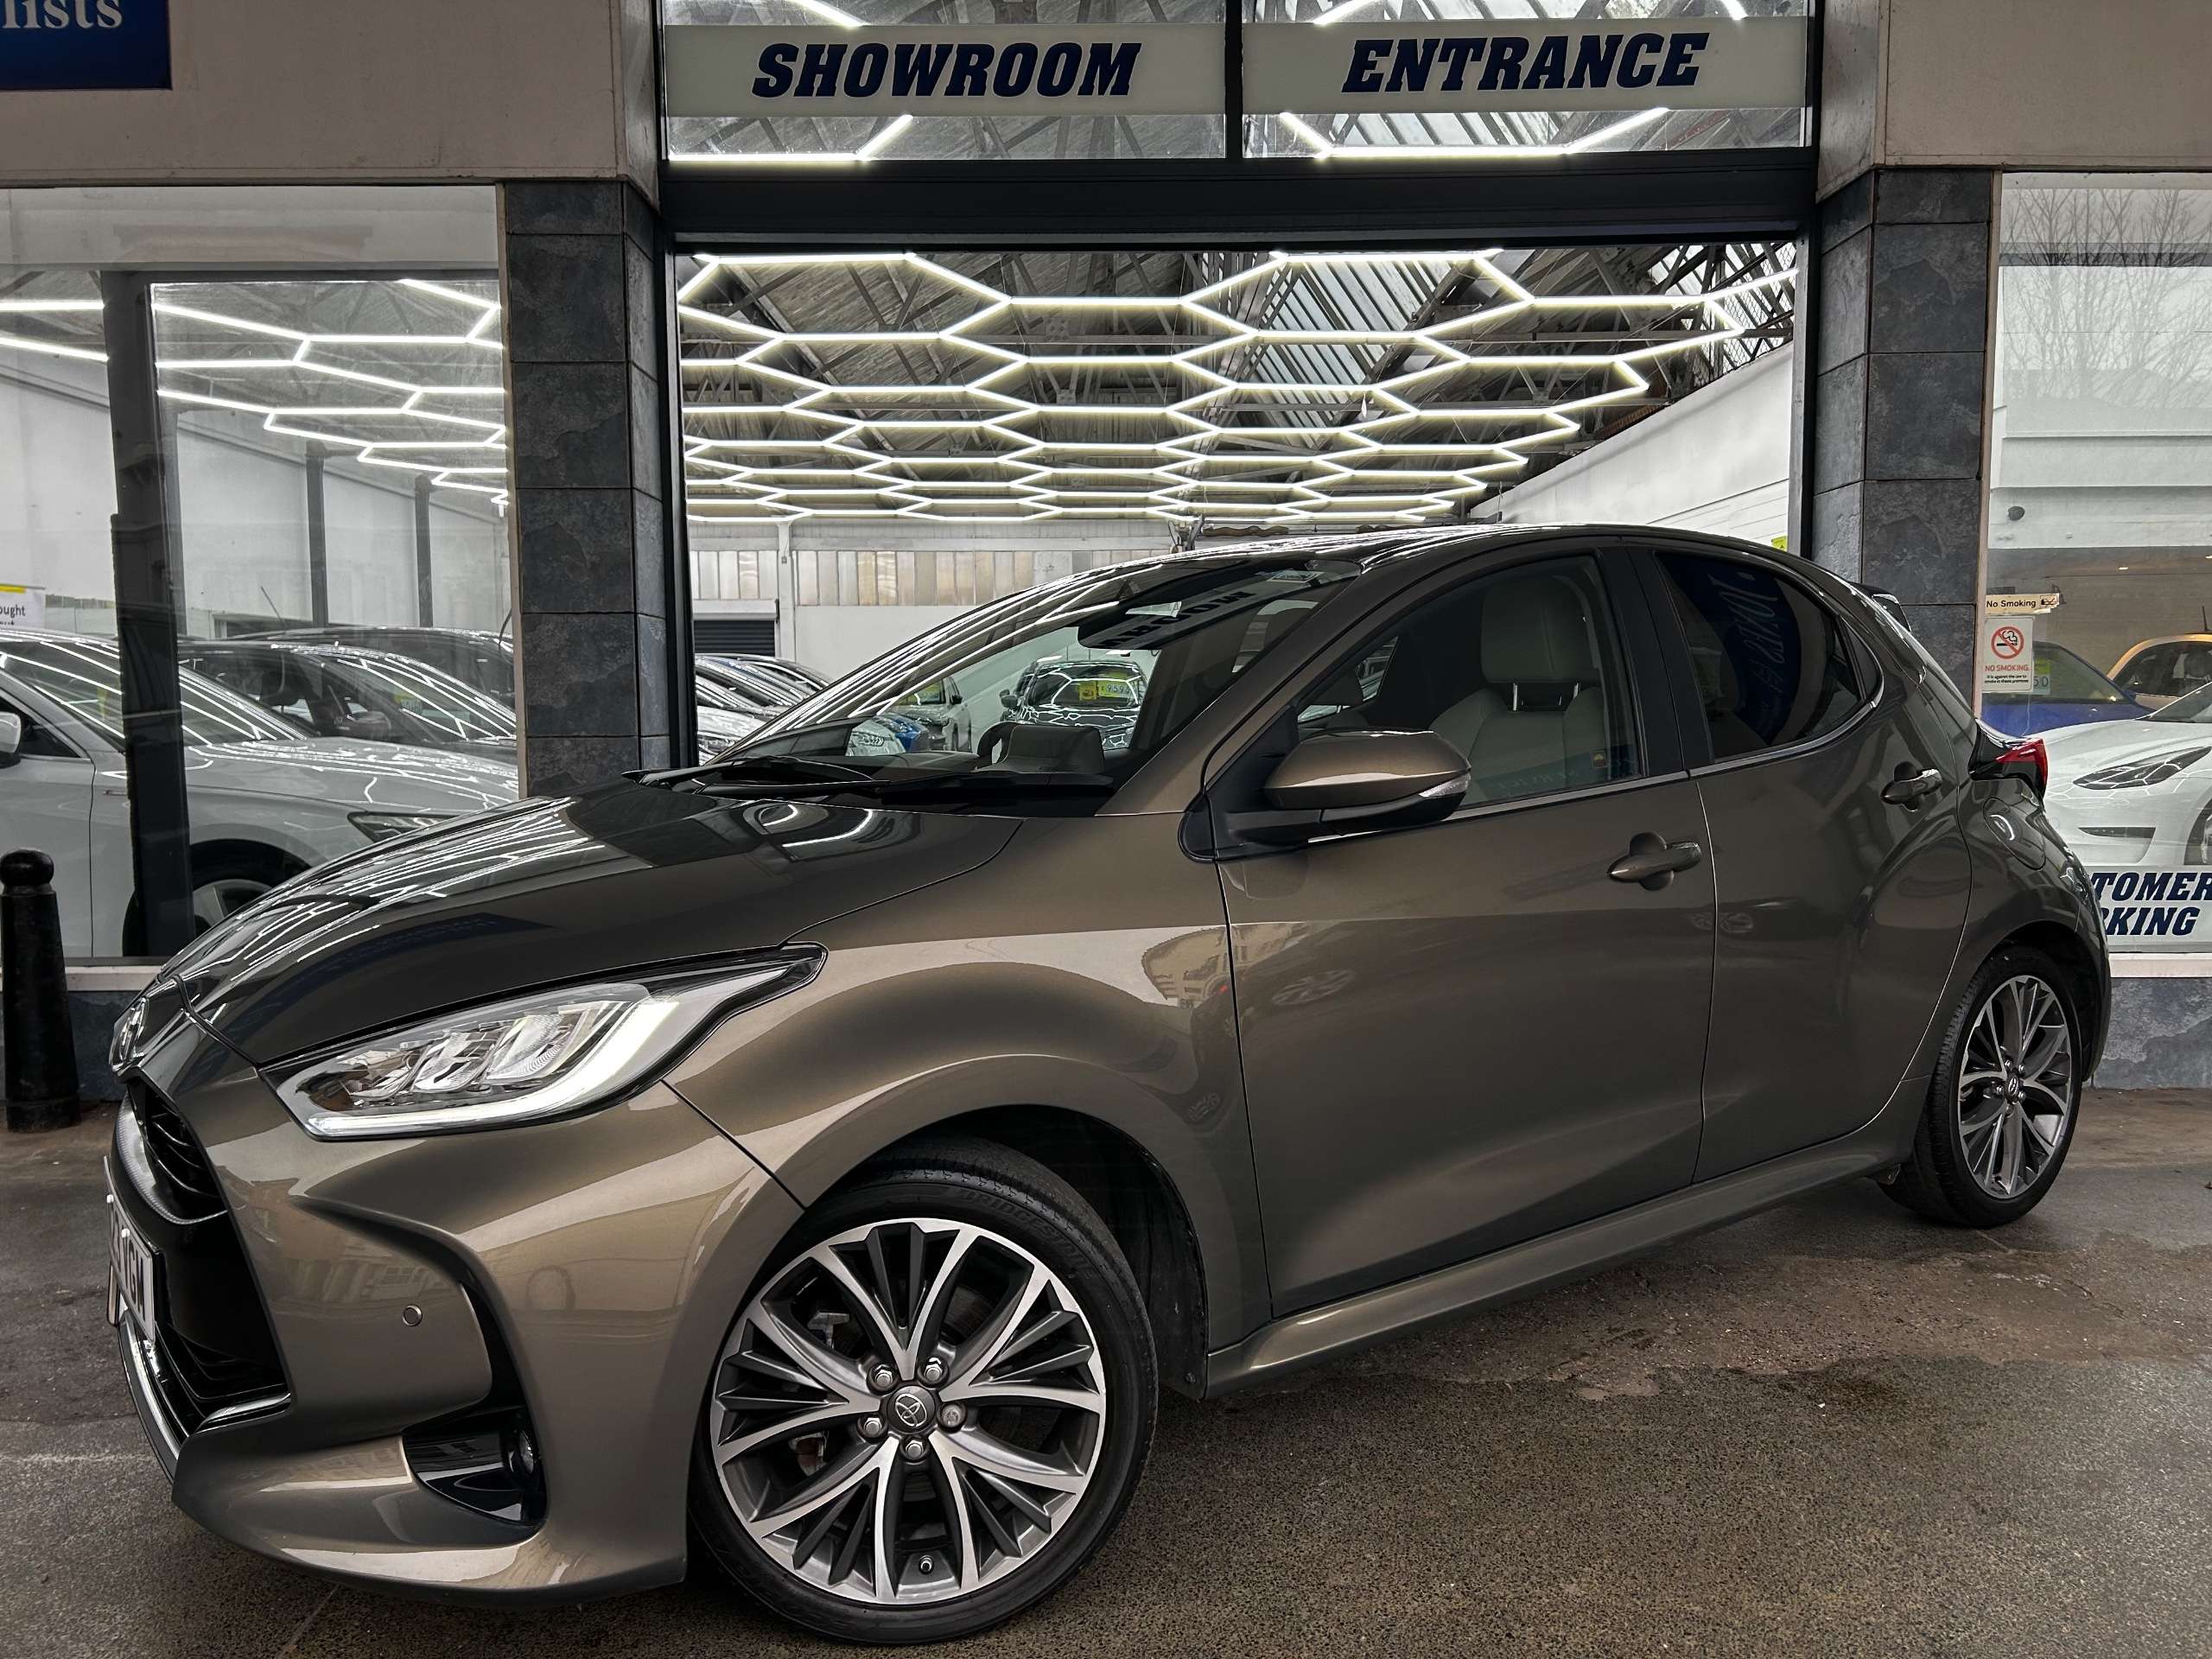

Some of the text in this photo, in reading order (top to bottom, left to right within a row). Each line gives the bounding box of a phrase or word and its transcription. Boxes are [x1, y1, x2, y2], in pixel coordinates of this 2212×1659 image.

[752, 42, 1142, 98] SHOWROOM
[1341, 32, 1710, 92] ENTRANCE
[2000, 600, 2037, 608] Smoking
[2091, 872, 2212, 901] TOMER
